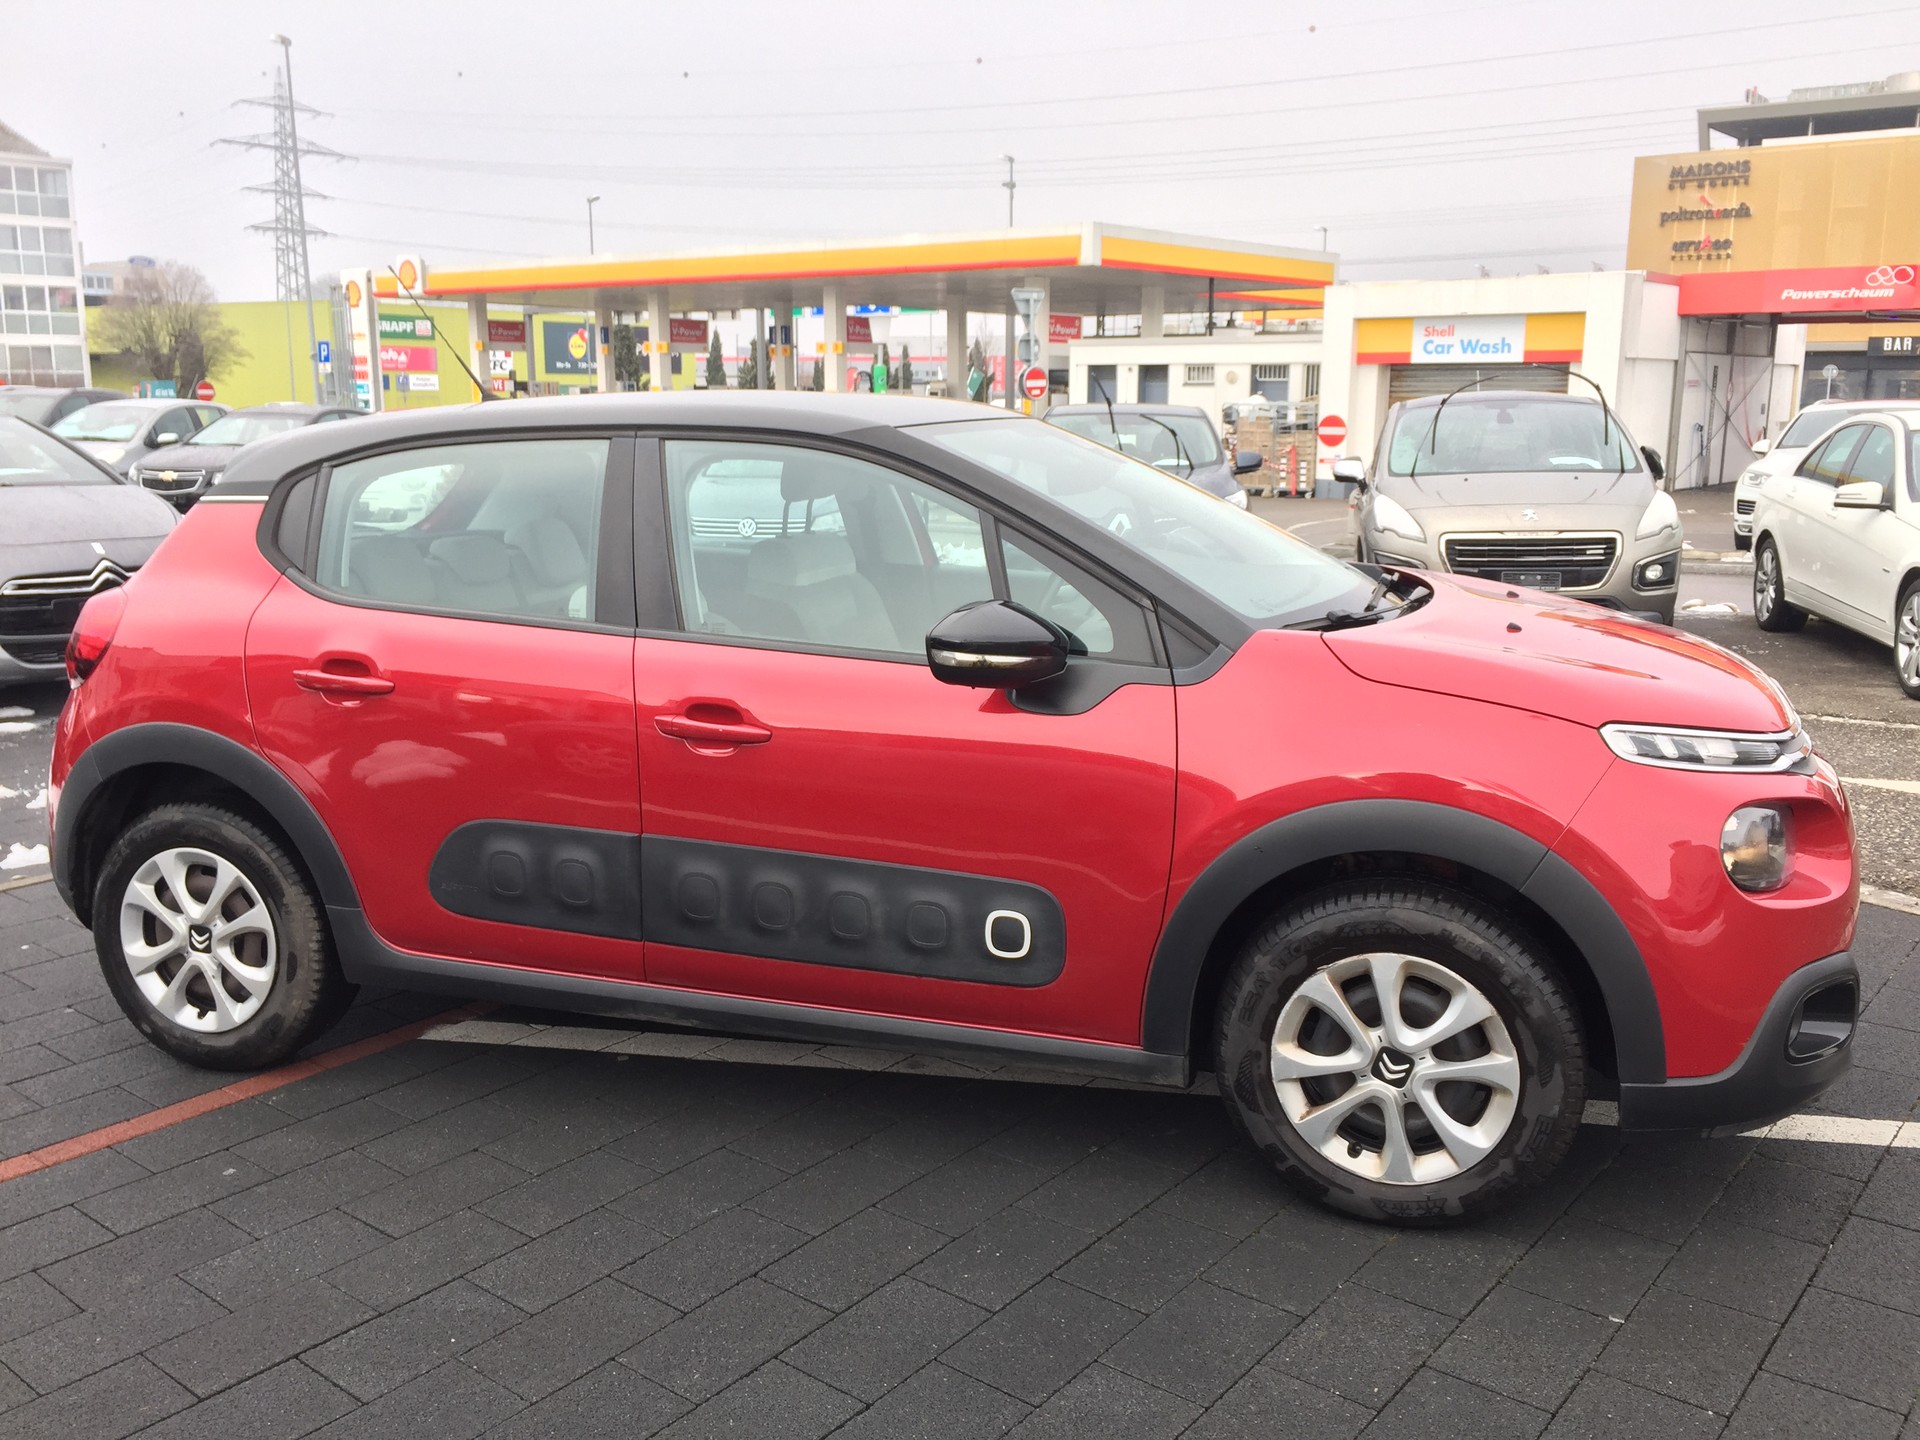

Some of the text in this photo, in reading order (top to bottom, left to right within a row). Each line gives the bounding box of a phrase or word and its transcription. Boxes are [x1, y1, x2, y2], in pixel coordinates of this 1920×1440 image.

[1670, 160, 1751, 178] MAISONS
[1781, 287, 1895, 300] Powerschaum
[1424, 324, 1455, 337] Shell
[1423, 336, 1512, 355] Car Wash
[1883, 337, 1912, 351] BAR
[320, 343, 328, 362] P
